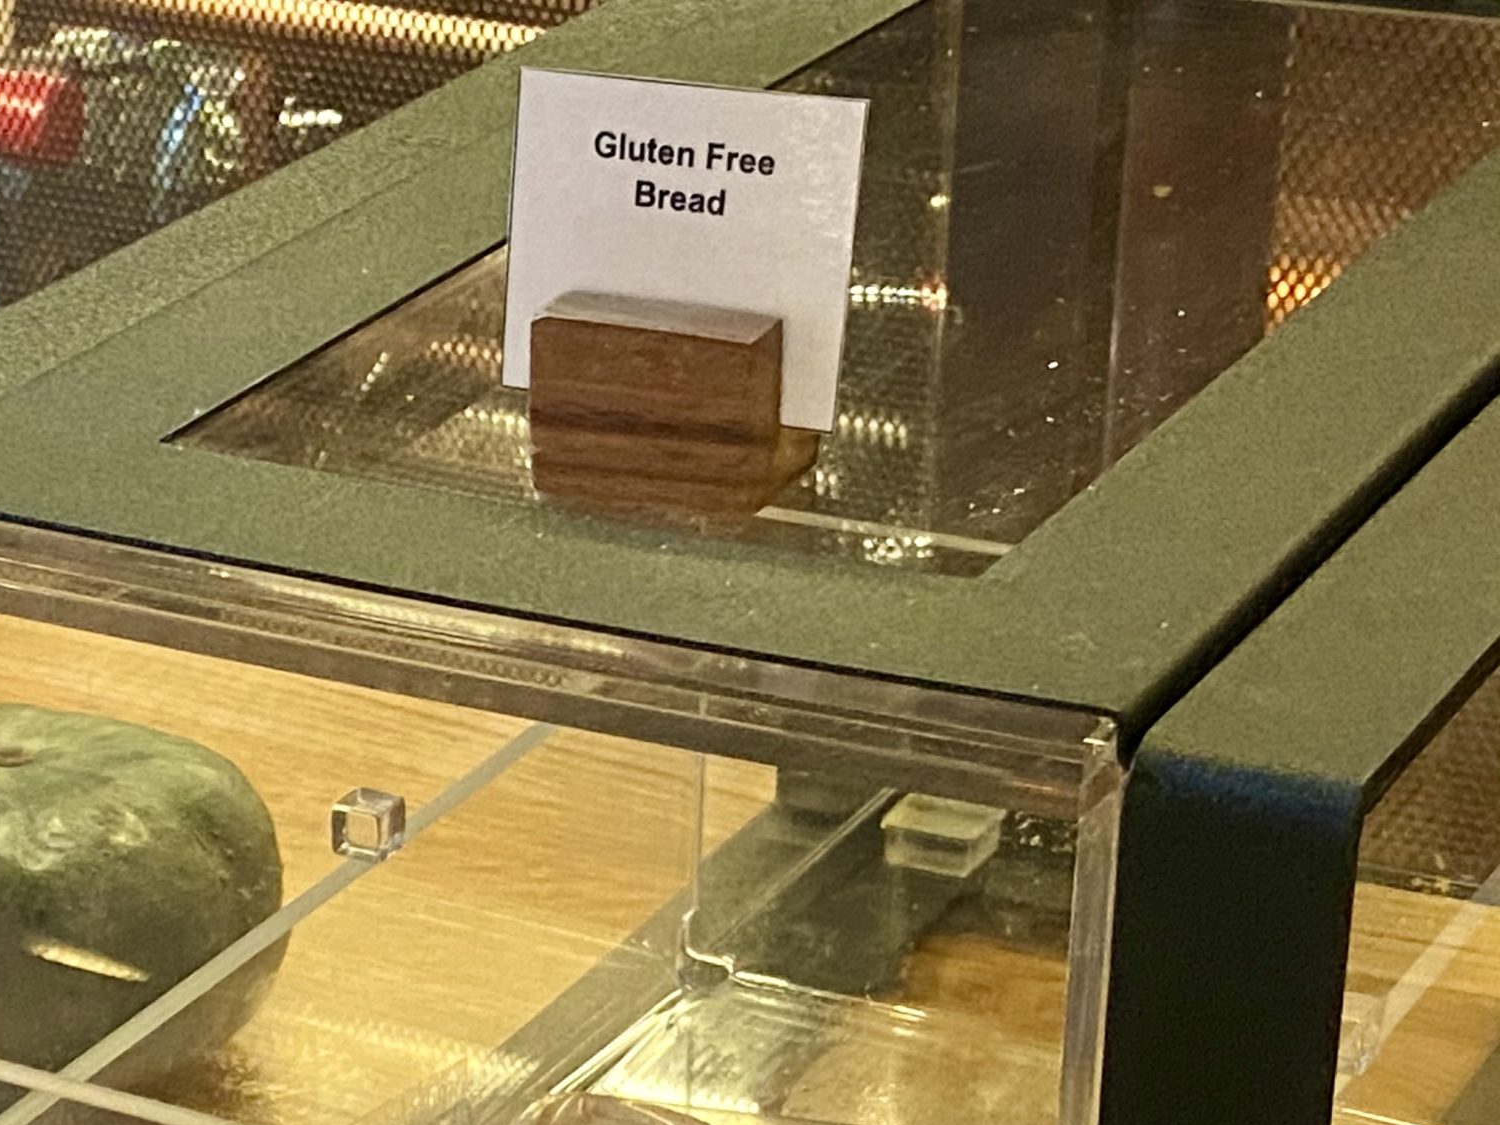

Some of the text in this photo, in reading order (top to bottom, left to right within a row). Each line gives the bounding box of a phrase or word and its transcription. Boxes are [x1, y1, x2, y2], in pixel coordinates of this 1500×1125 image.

[594, 130, 775, 175] Gluten Free
[634, 180, 726, 215] Bread
